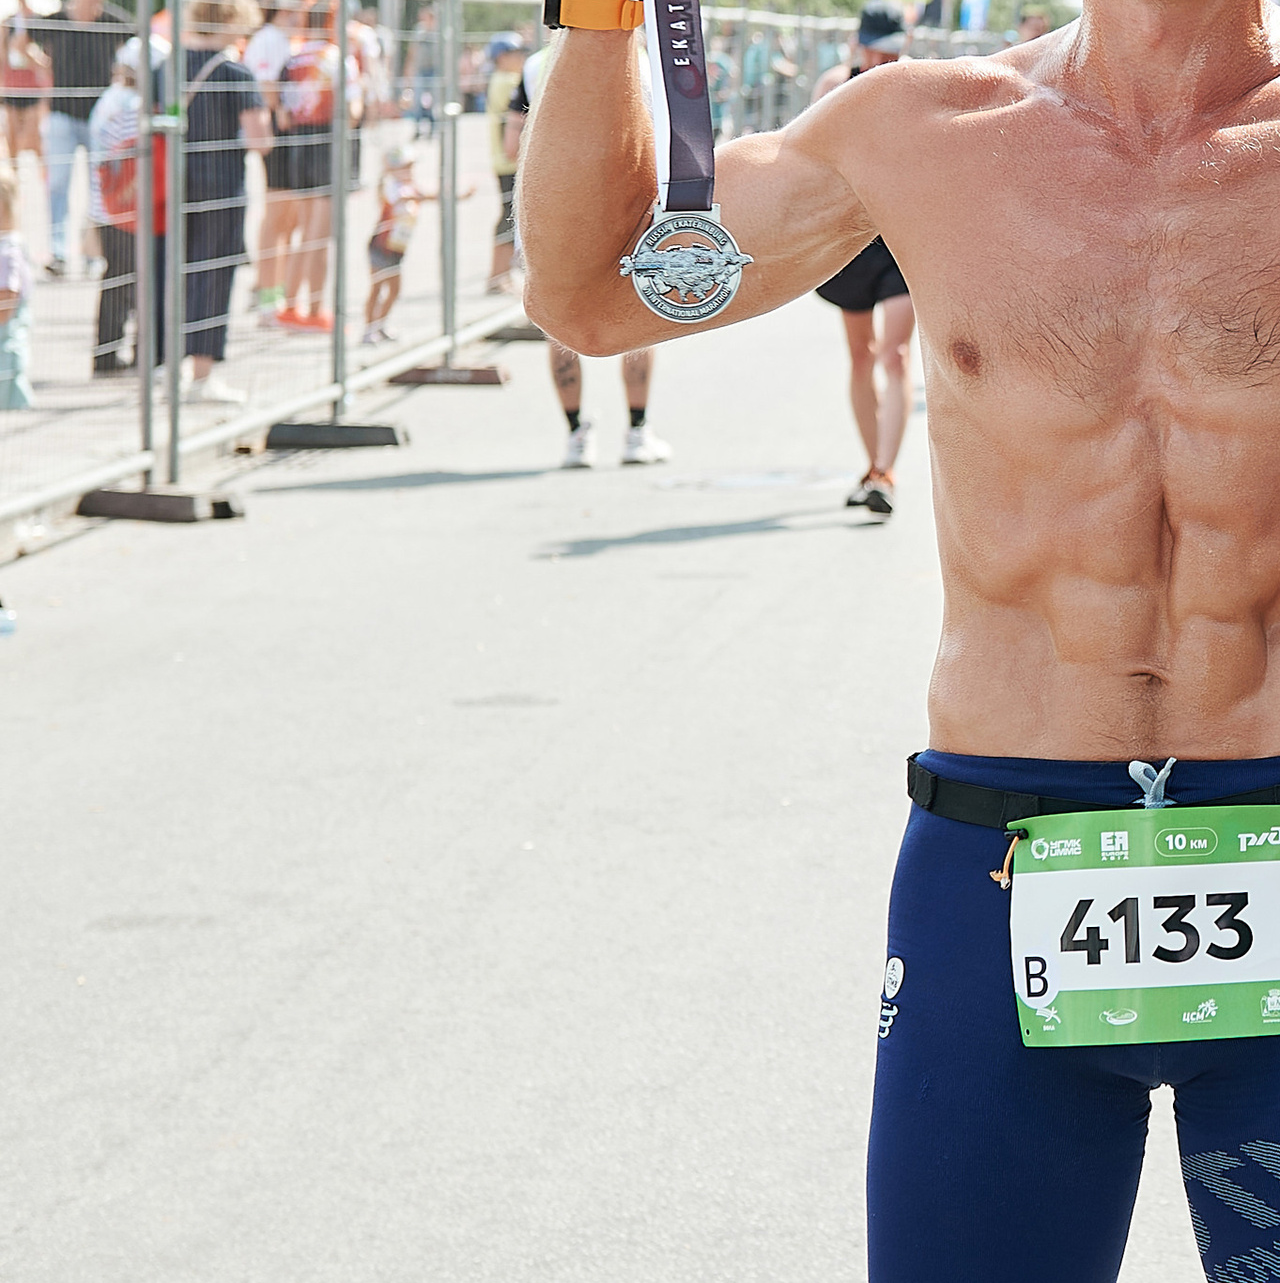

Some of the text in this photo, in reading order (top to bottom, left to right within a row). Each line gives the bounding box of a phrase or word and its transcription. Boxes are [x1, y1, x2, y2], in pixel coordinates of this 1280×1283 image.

[646, 219, 728, 246] RUSSIA EKATERINBURG
[700, 286, 731, 316] MARATHON
[1165, 833, 1187, 851] 10
[1060, 891, 1254, 966] 4133
[1024, 956, 1049, 998] B
